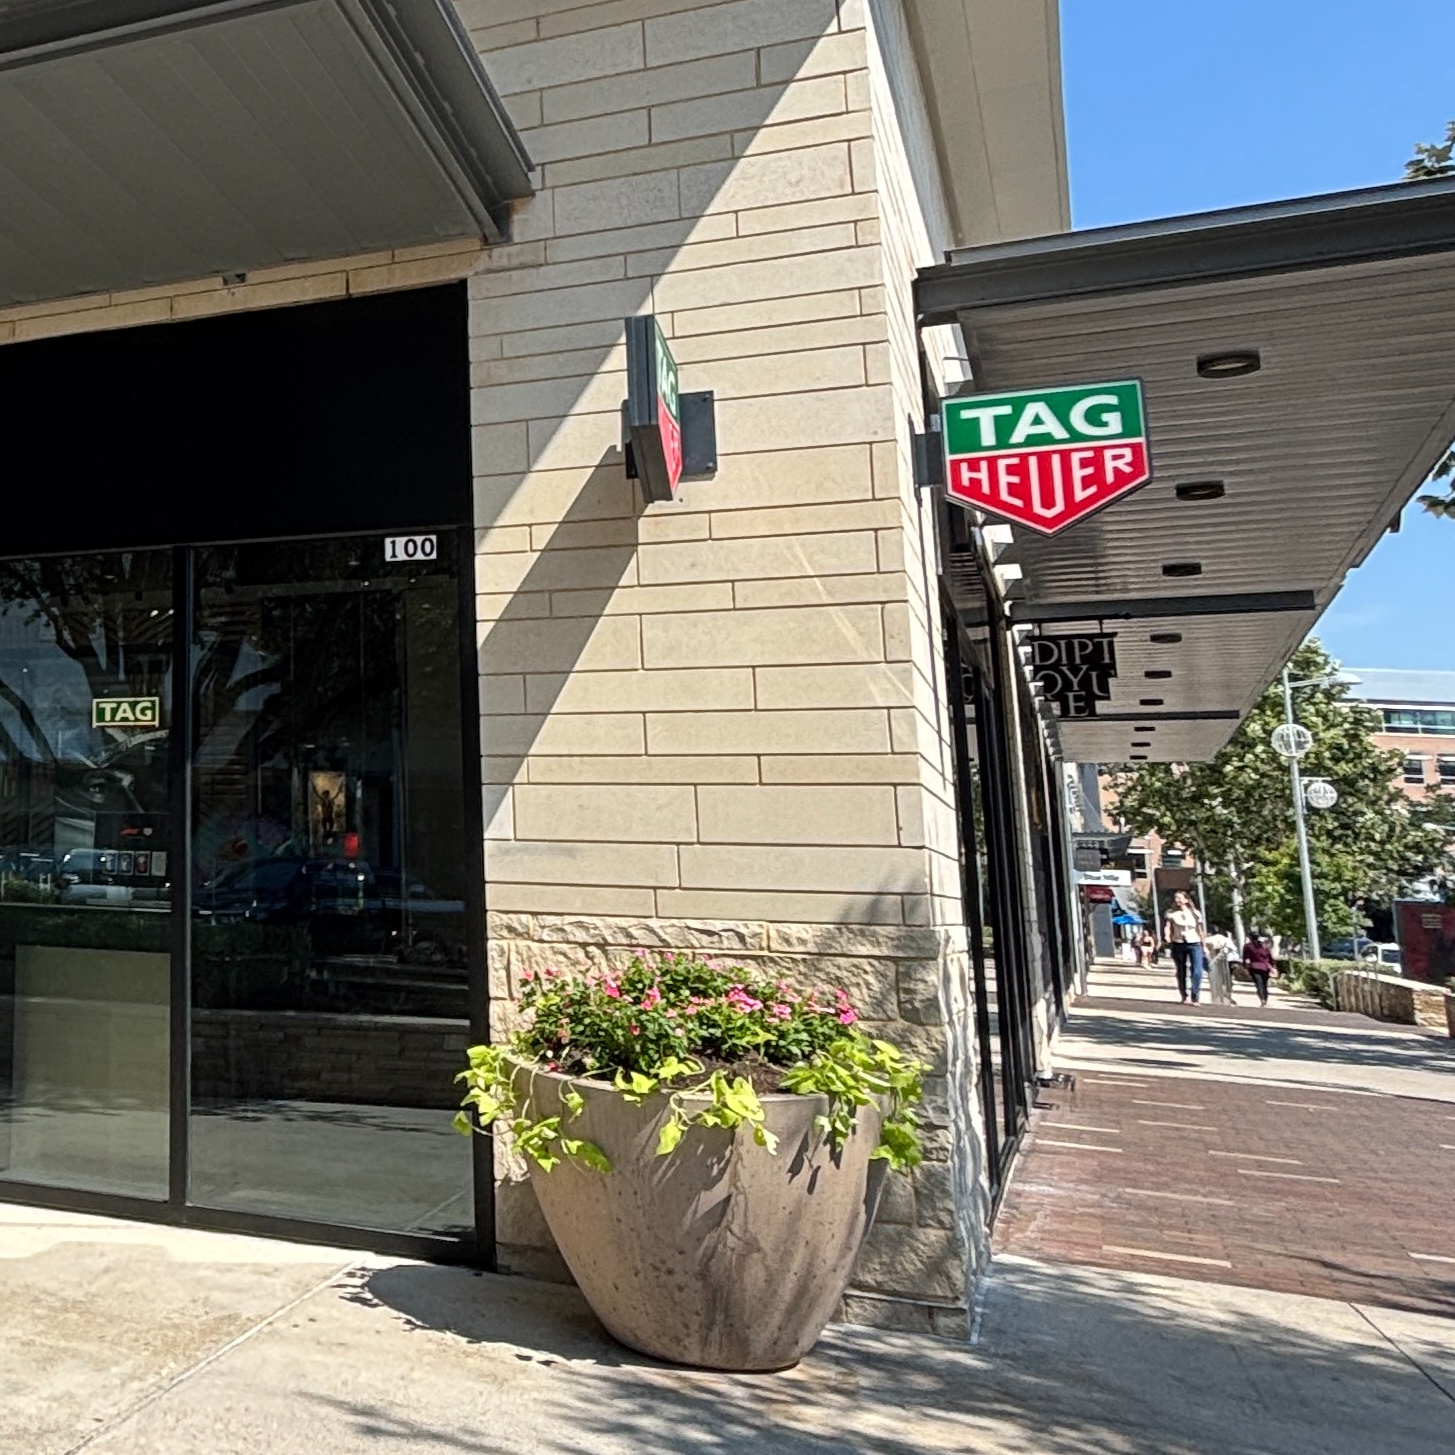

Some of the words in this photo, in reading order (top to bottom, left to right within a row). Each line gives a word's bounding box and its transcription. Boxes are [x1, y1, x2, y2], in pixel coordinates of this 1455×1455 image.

[959, 394, 1123, 447] TAG
[960, 447, 1134, 518] HEUER
[389, 537, 435, 559] 100
[1032, 638, 1115, 666] DIPT
[99, 702, 152, 721] TAG
[1064, 691, 1089, 717] E
